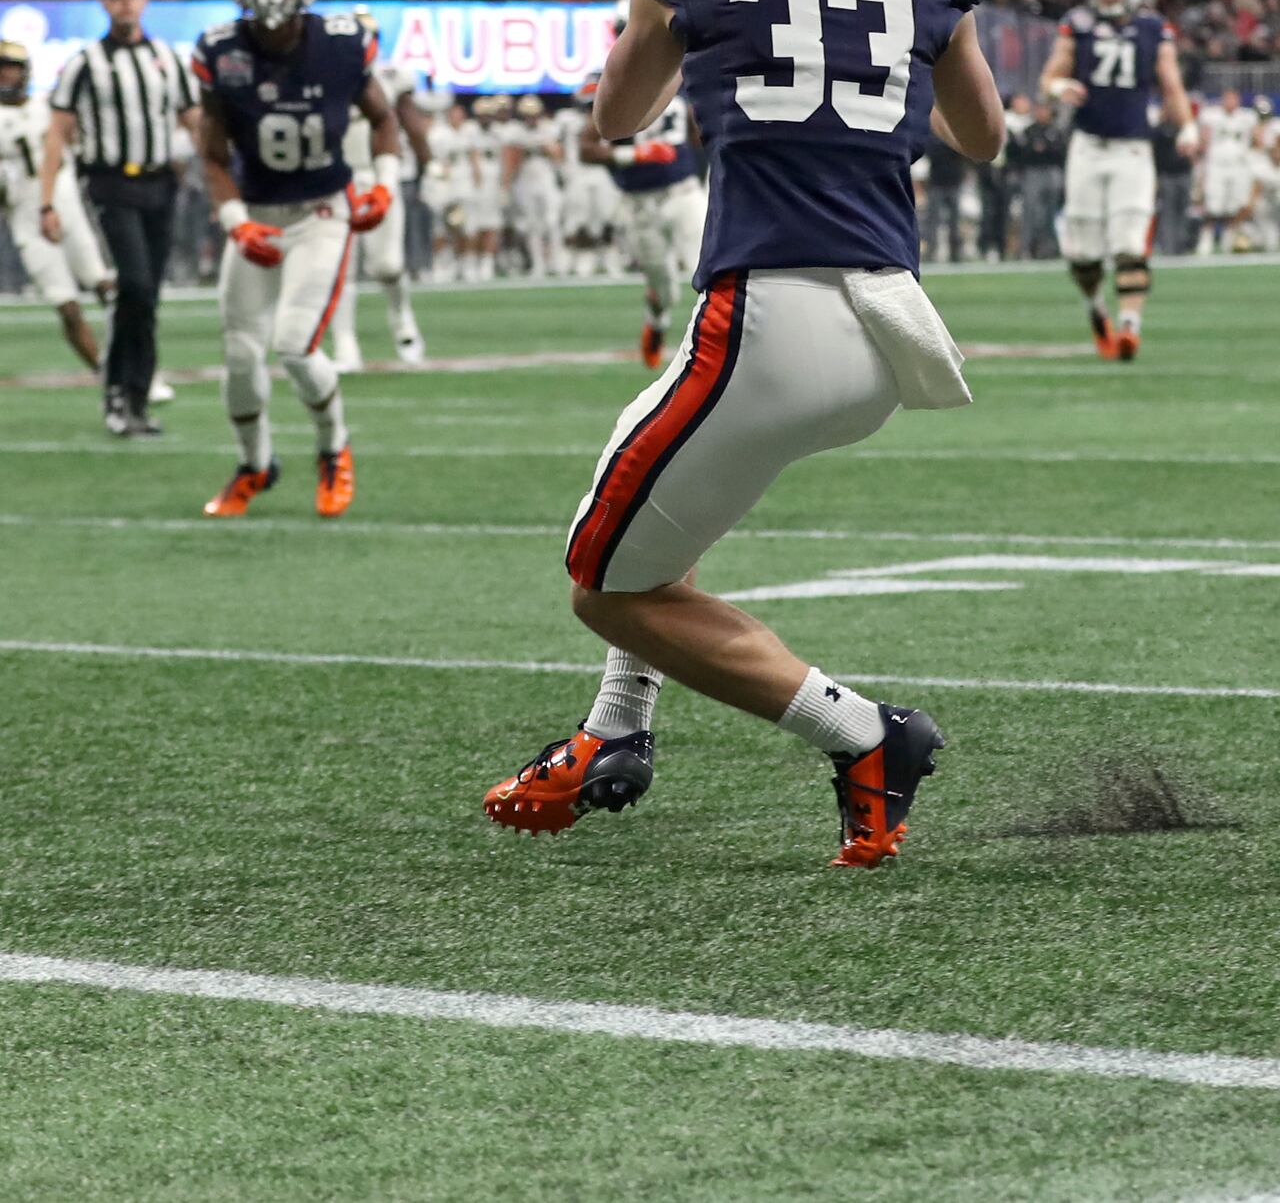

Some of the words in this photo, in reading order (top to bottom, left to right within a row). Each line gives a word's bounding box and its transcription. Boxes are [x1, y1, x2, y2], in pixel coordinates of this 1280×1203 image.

[391, 4, 617, 86] AUBU
[1090, 38, 1137, 89] 71
[258, 113, 334, 173] 81
